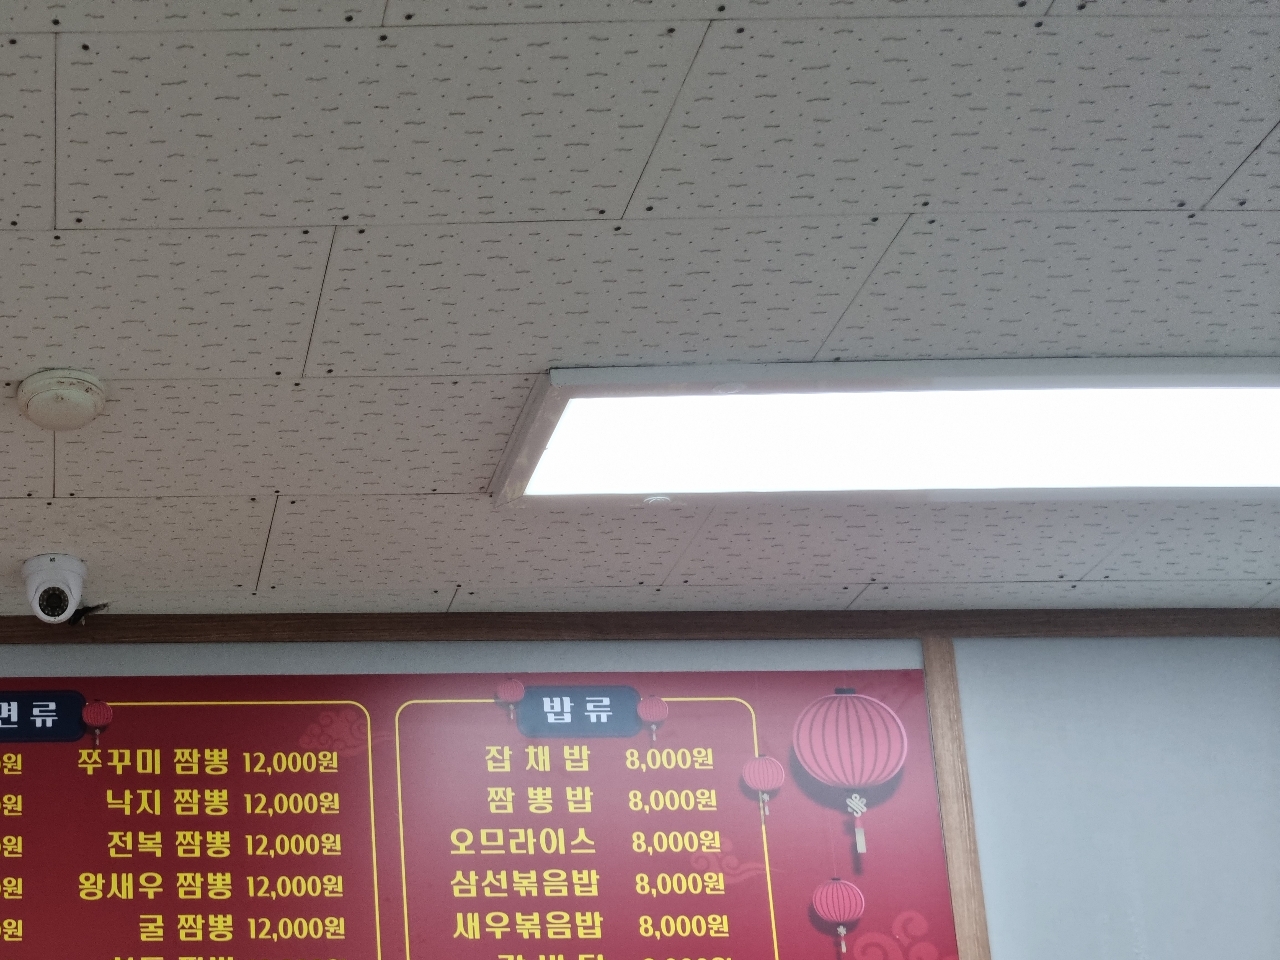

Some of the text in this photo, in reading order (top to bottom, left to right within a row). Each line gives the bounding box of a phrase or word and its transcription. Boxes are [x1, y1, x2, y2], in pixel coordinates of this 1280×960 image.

[77, 748, 339, 776] 쭈꾸미 짬뽕 12,000원
[625, 747, 714, 772] 8,000원
[106, 788, 340, 818] 낙지 짬뽕 12,000원
[628, 788, 717, 813] 8,000원
[107, 830, 342, 859] 전복 짬뽕 12,000원
[450, 827, 721, 855] 오므라이스 8,000원
[78, 871, 344, 901] 왕새우 짬뽕 12,000원
[450, 868, 726, 898] 삼선볶음밥 8,000원
[138, 913, 346, 943] 굴 짬뽕 12,000원
[452, 910, 730, 940] 새우볶음밥 8,000원
